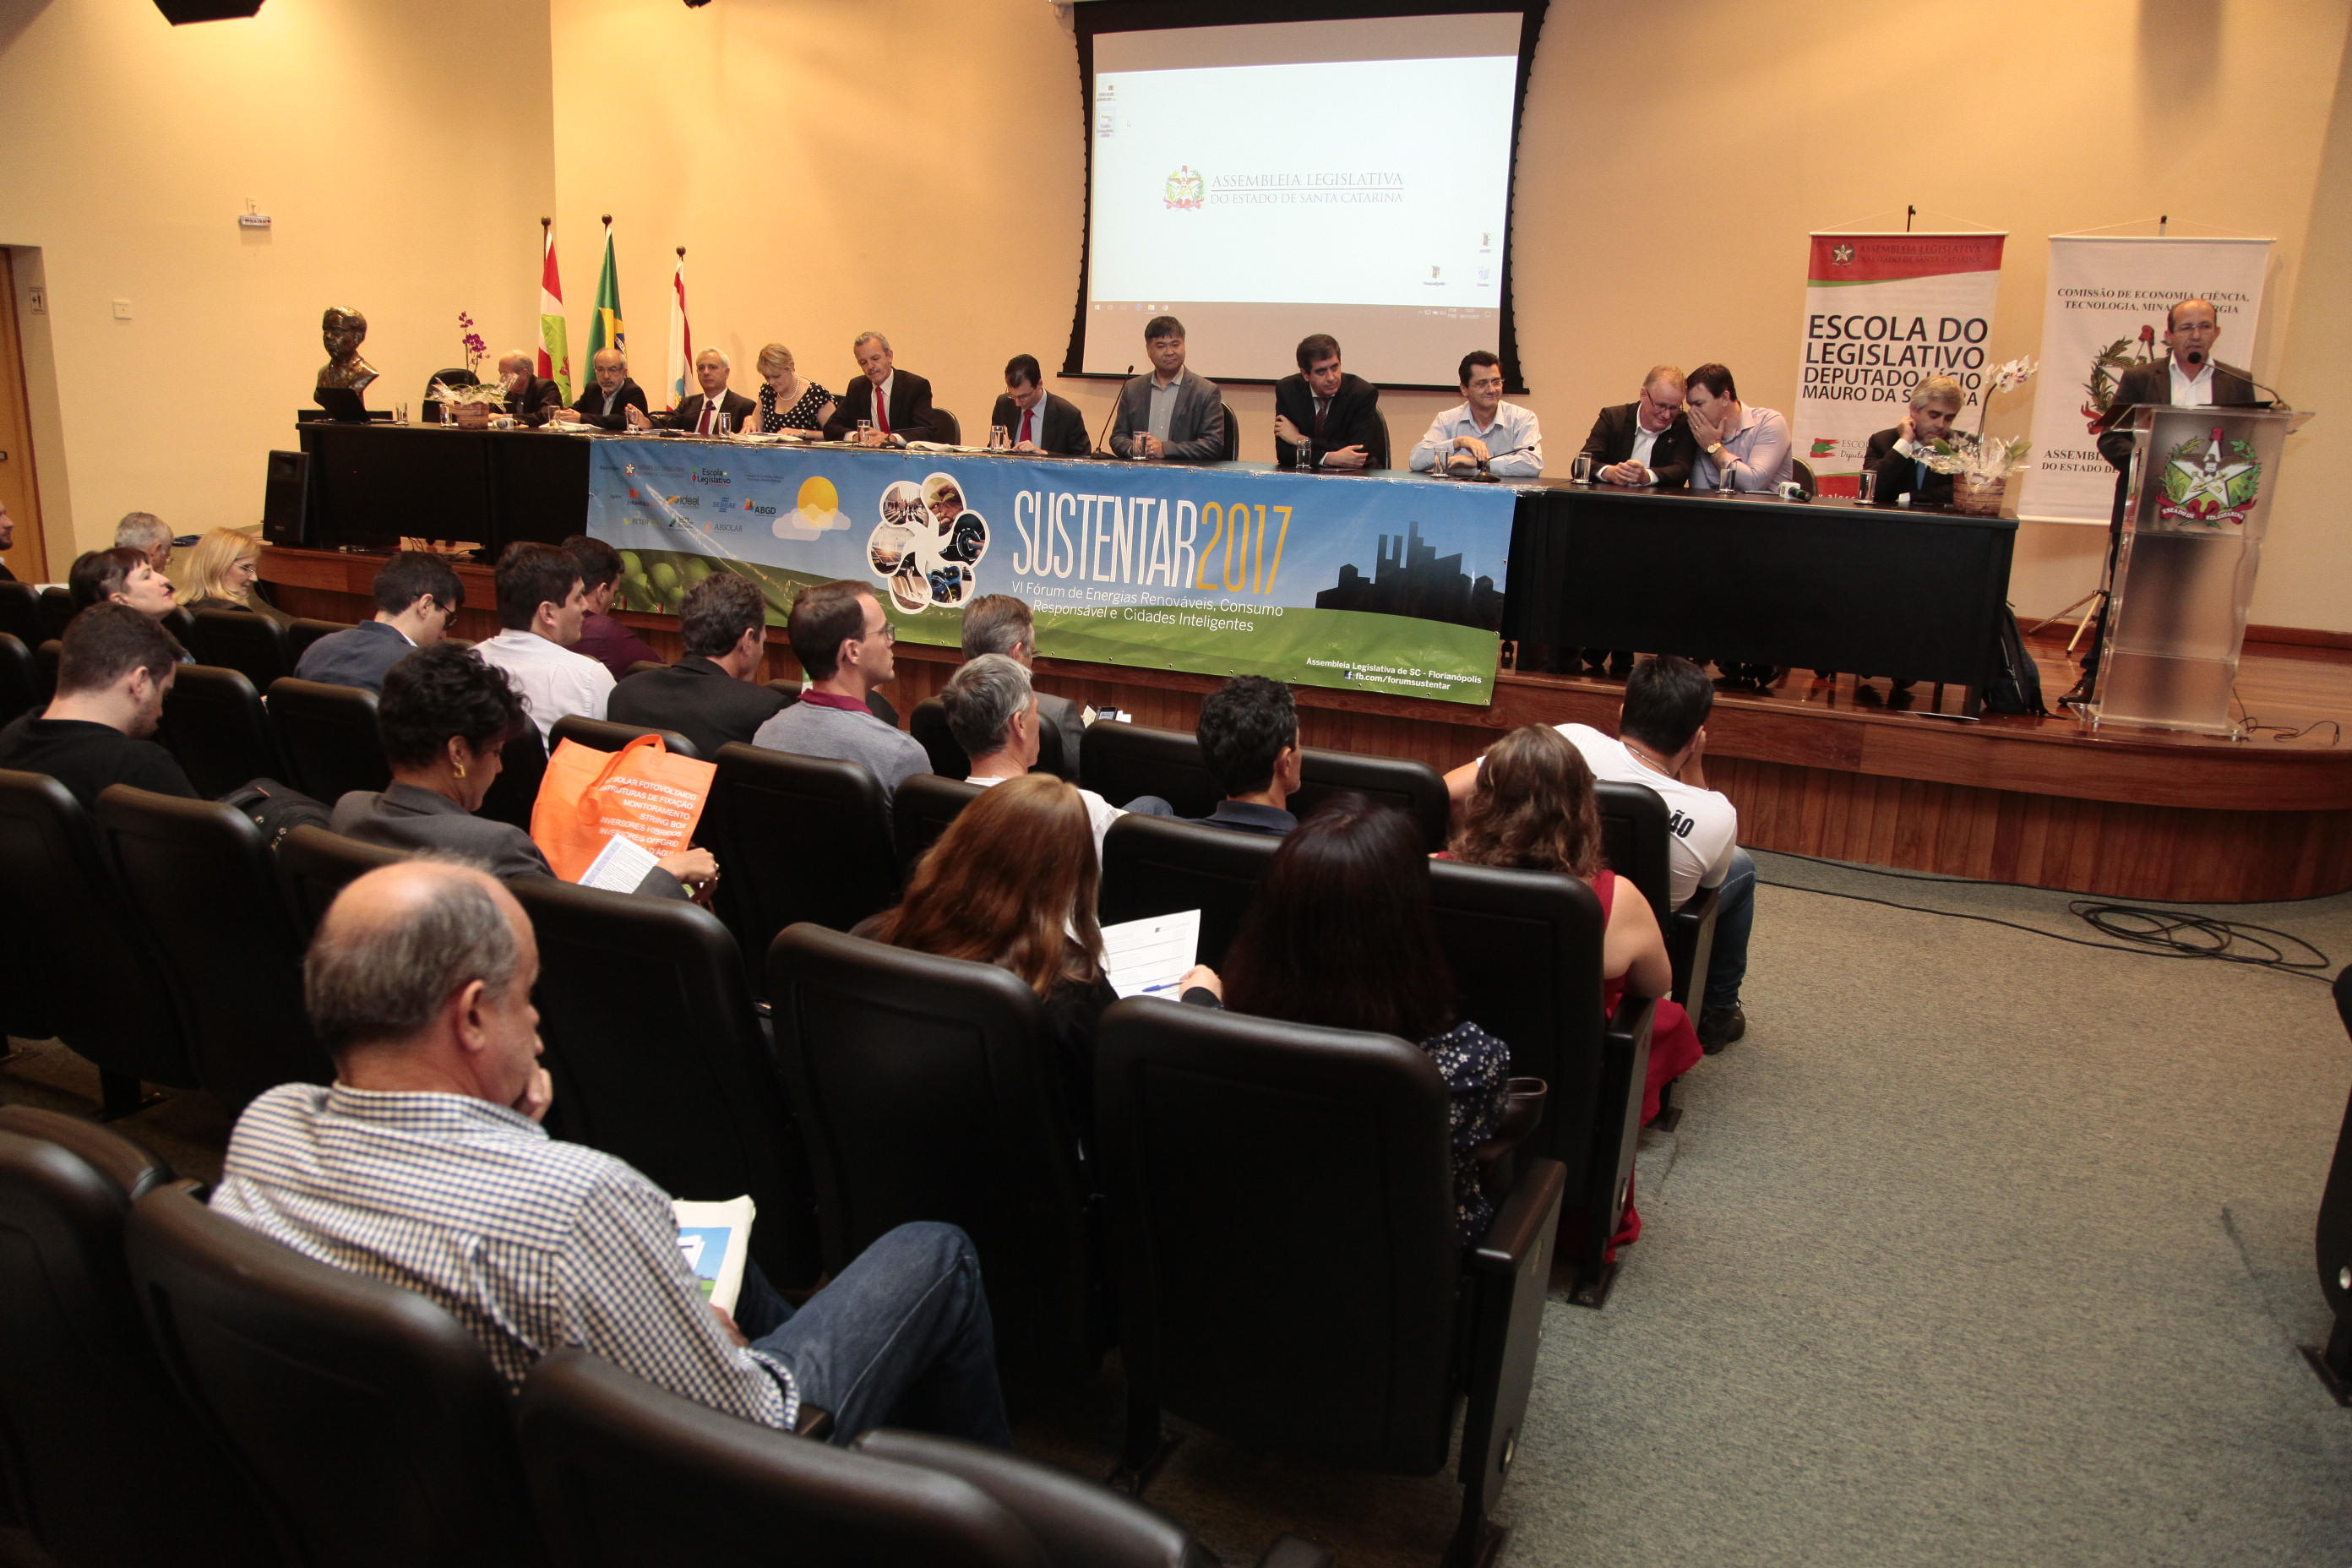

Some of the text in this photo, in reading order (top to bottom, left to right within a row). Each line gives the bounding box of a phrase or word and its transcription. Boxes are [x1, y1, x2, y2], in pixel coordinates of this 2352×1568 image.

[1211, 172, 1403, 188] ASSEMBLEIA LEGISLATIVA
[1211, 193, 1403, 204] DO ESTADO DE SANTA CATARINA
[2057, 287, 2115, 298] COMISSÃO
[2117, 291, 2131, 299] DE
[2200, 291, 2250, 302] CIÊNCIA,
[2065, 301, 2139, 312] TECNOLOGIA,
[2142, 303, 2175, 312] MINA
[1808, 314, 1988, 344] ESCOLA DO
[1805, 342, 1984, 369] LEGISLATIVO
[1804, 367, 1919, 388] DEPUTADO
[1802, 384, 1867, 401] MAURO
[1871, 388, 1897, 403] DA
[2044, 449, 2105, 460] ASSEMBL
[702, 468, 723, 476] Escola
[2042, 462, 2057, 471] DO
[2060, 463, 2102, 473] ESTADO
[697, 476, 732, 485] Legislativo
[679, 496, 700, 506] ideal
[754, 506, 776, 514] ABGD
[2162, 508, 2186, 516] ESTADO
[714, 524, 743, 532] ABSOLAR
[1012, 581, 1283, 617] VI Fórum de Energias Renováveis, Consumo
[1033, 600, 1254, 632] Responsável e Cidades Inteligentes
[1306, 657, 1350, 669] Assembleia
[1353, 662, 1396, 675] Legislativa
[1397, 667, 1407, 676] de
[1409, 668, 1421, 677] SC
[1429, 670, 1482, 683] Florianópolis
[1355, 672, 1451, 690] fb.com/forumsustentar
[612, 776, 638, 787] SOLAR
[639, 781, 697, 801] FOTOVOLTAICO
[599, 785, 647, 799] STRUTURAS
[659, 796, 694, 809] FIXAÇÃO
[623, 799, 690, 819] MONITORAMENTO
[600, 816, 645, 831] INVERSORES
[640, 813, 687, 829] STRING BOX
[1669, 808, 1695, 839] ÃO
[599, 827, 679, 847] INVERSORES OFFGRID
